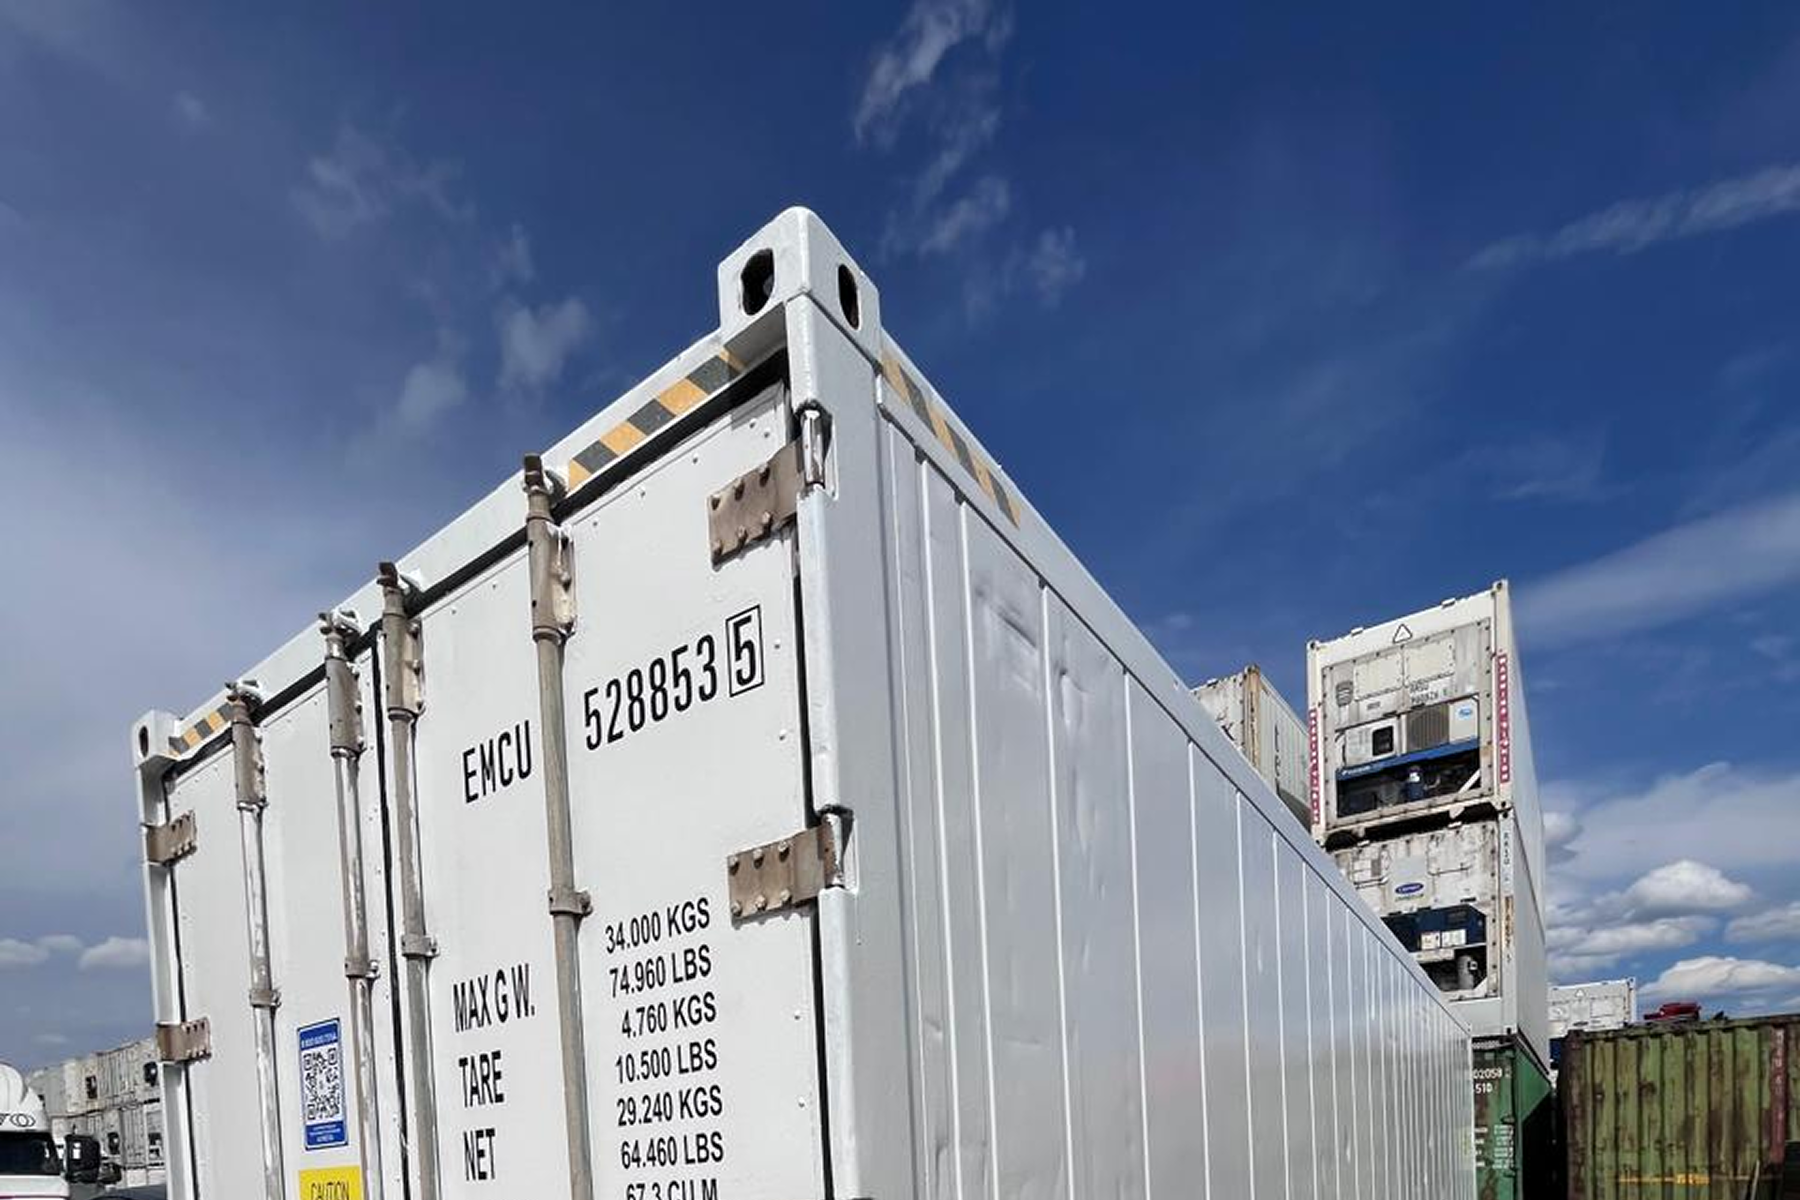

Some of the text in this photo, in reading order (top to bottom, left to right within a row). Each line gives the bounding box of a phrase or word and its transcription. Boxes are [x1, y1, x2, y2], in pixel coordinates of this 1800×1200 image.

[463, 614, 757, 803] EMCU 528853 5
[605, 897, 710, 954] 34.000 KGS
[609, 944, 712, 998] 74.960 LBS
[454, 974, 492, 1032] MAX
[622, 991, 717, 1039] 4.760 KGS
[459, 1050, 505, 1108] TARE
[615, 1038, 717, 1084] 10.500 LBS
[617, 1085, 723, 1127] 29.240 KGS
[464, 1128, 496, 1181] NET
[621, 1131, 724, 1169] 64.460 LBS
